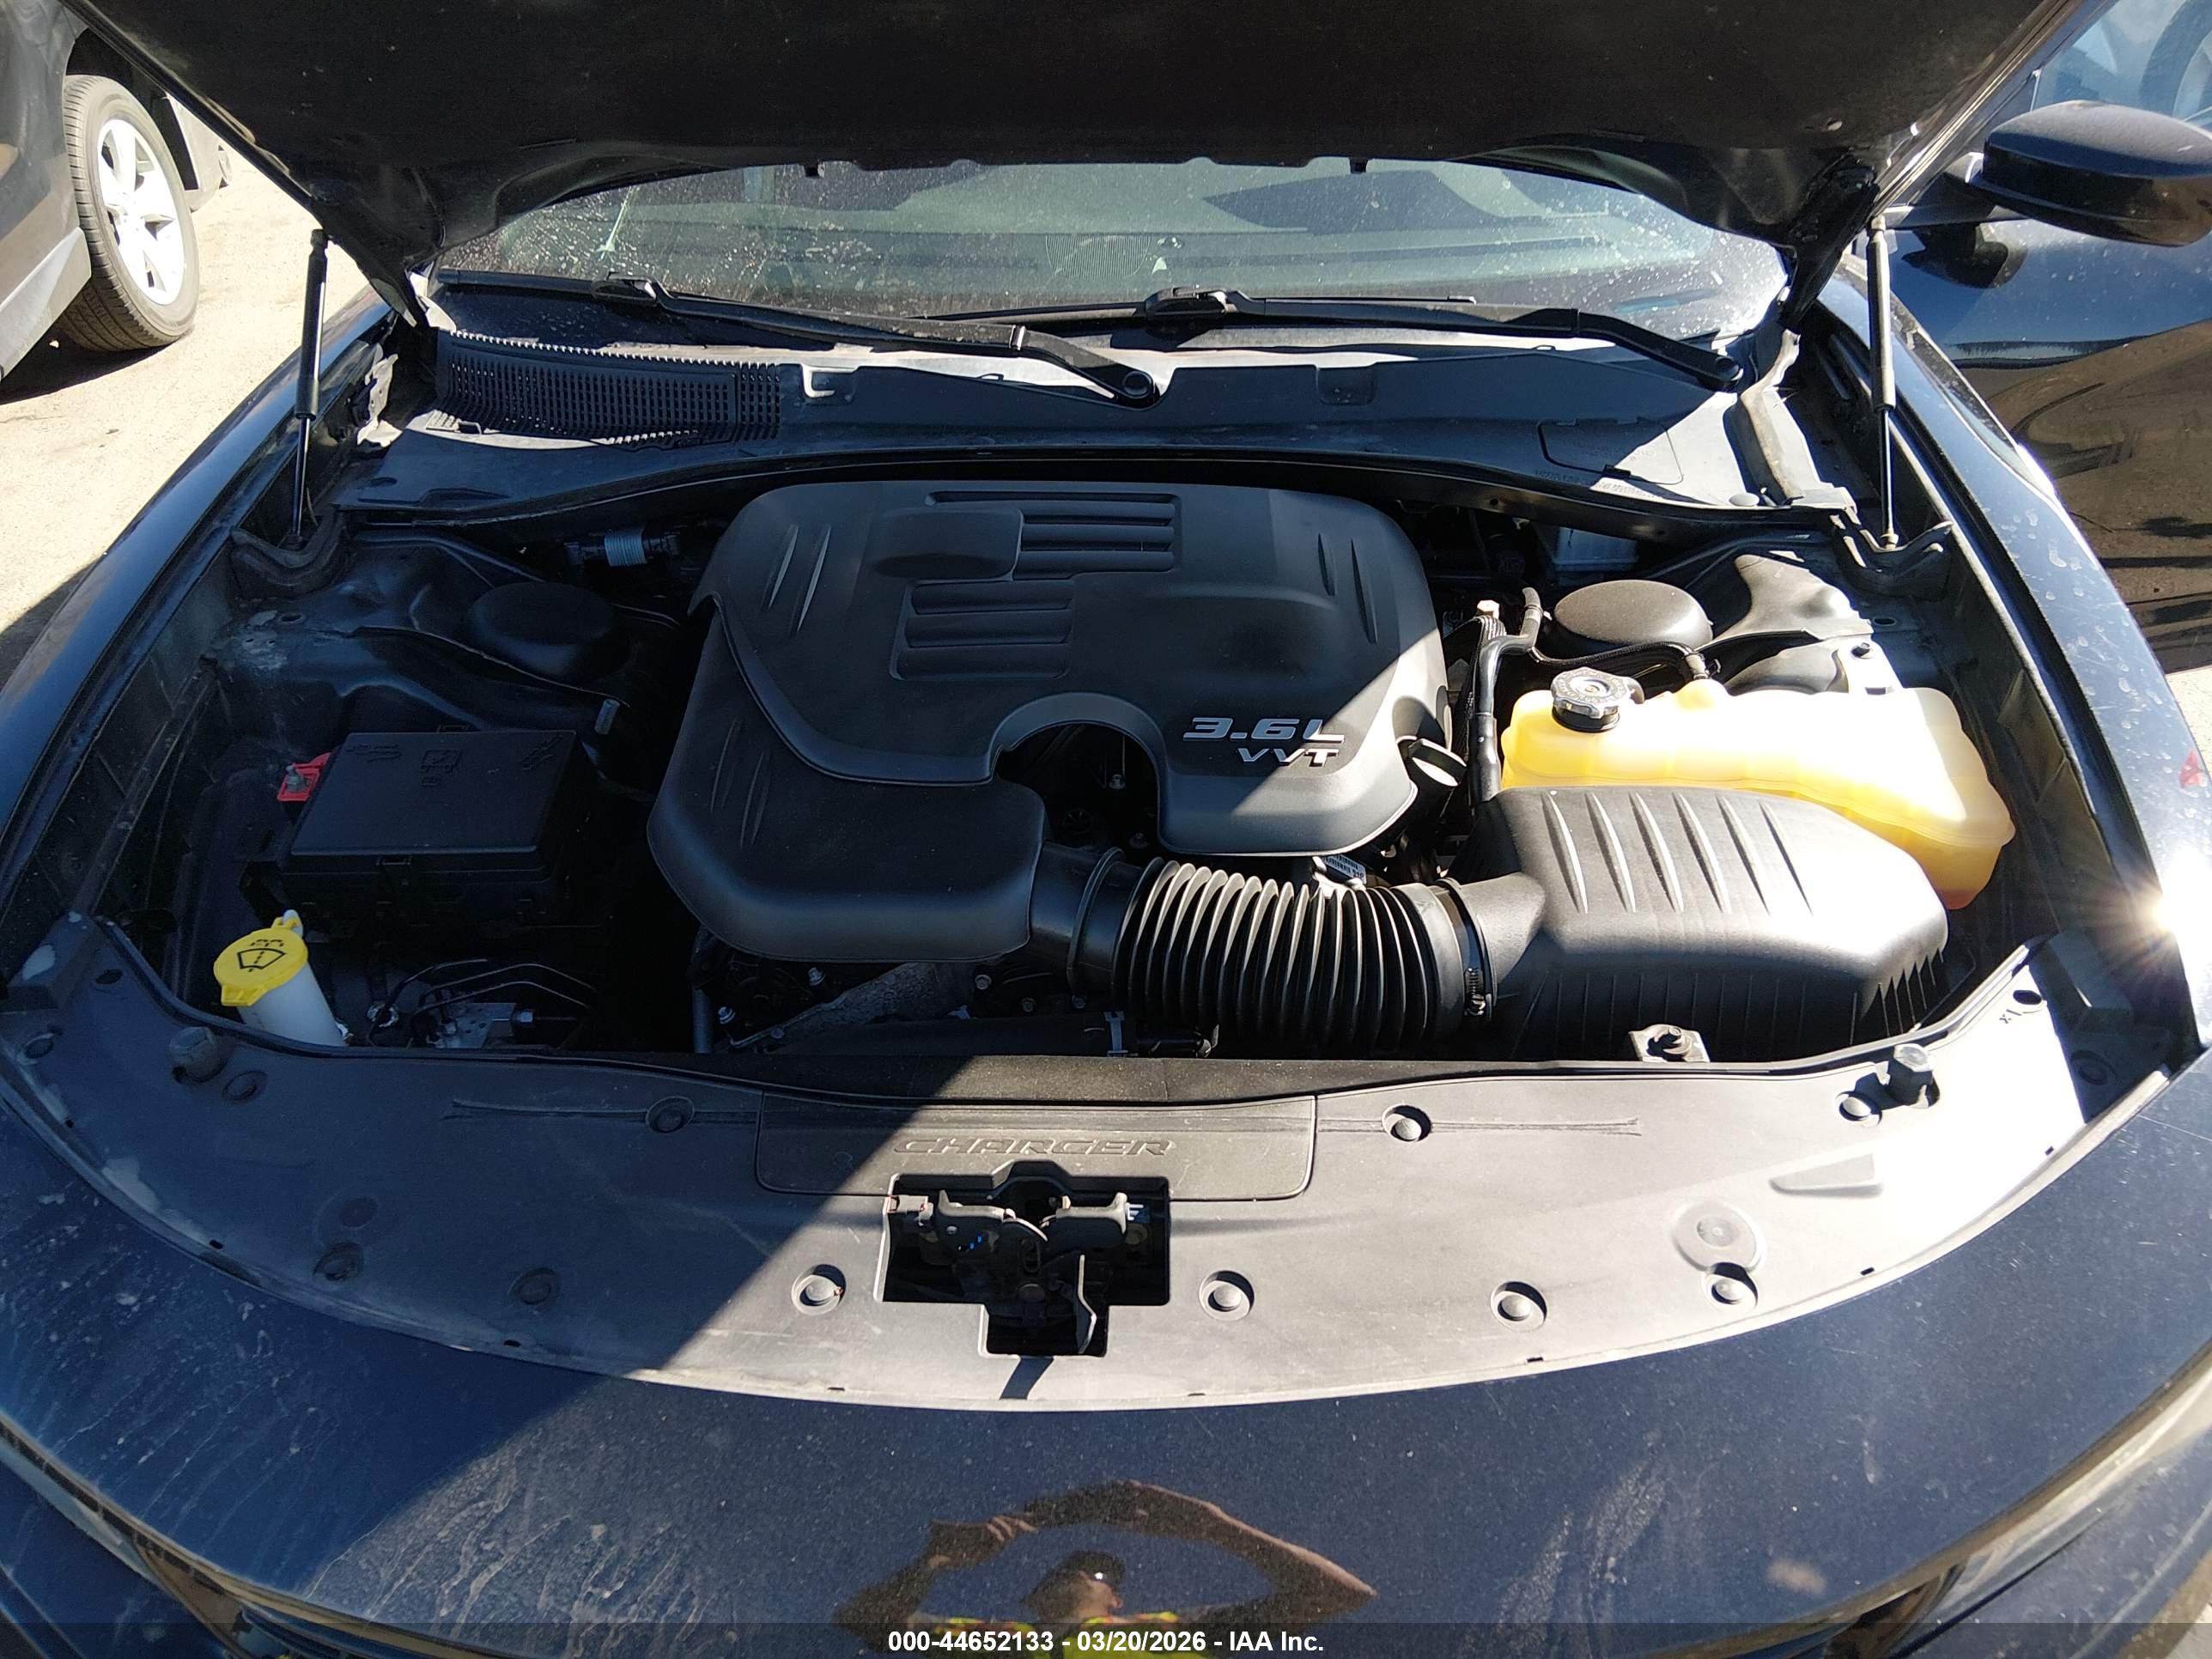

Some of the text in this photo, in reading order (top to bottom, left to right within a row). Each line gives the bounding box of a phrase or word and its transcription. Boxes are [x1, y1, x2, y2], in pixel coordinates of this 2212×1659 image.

[1182, 717, 1345, 743] 3.6L
[1237, 748, 1340, 767] VVT
[893, 1138, 1176, 1157] CHARGER
